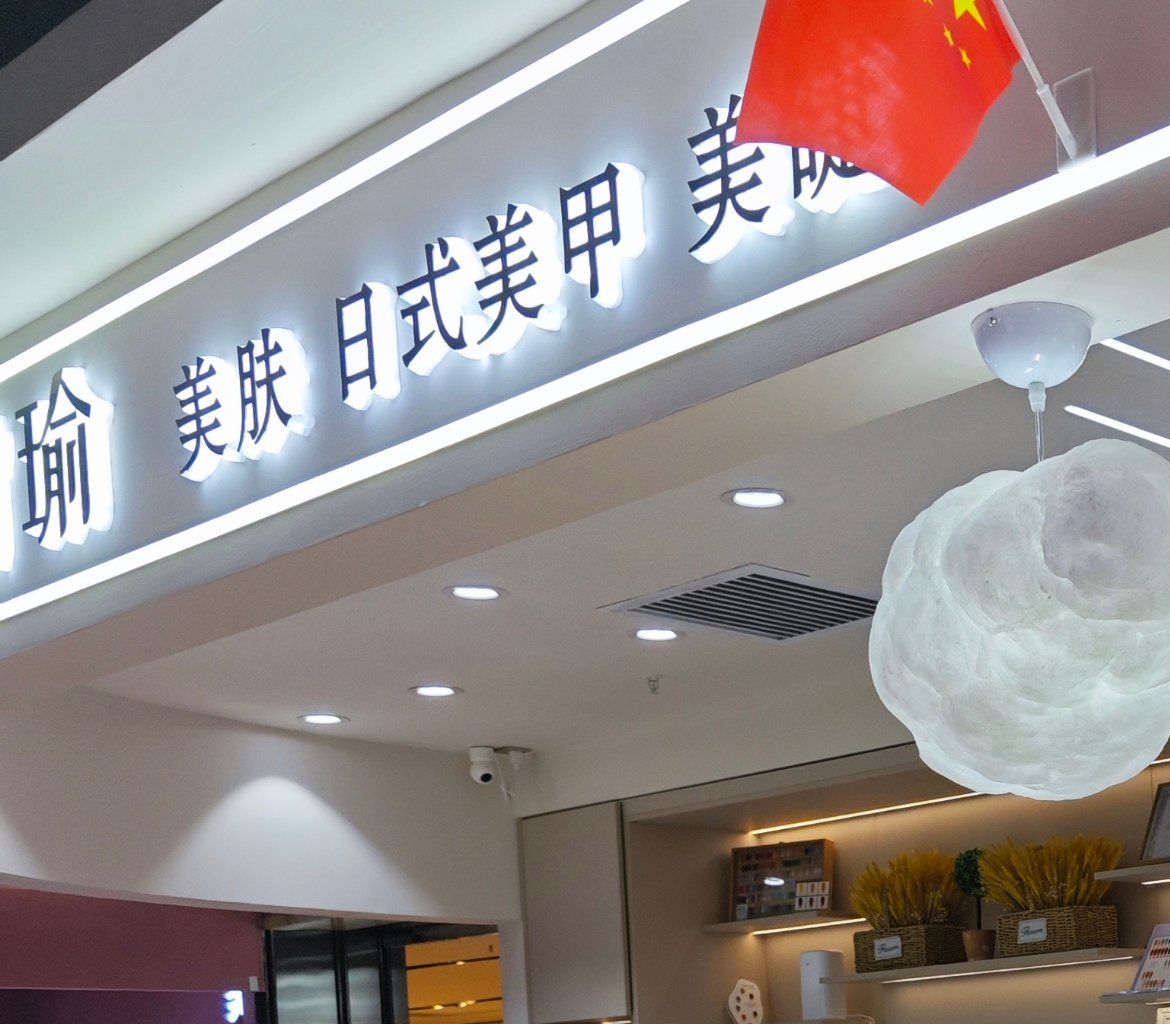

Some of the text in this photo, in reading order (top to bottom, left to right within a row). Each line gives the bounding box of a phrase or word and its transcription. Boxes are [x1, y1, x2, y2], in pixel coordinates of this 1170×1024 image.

[173, 328, 292, 474] 美肤
[336, 162, 622, 401] 日式美甲
